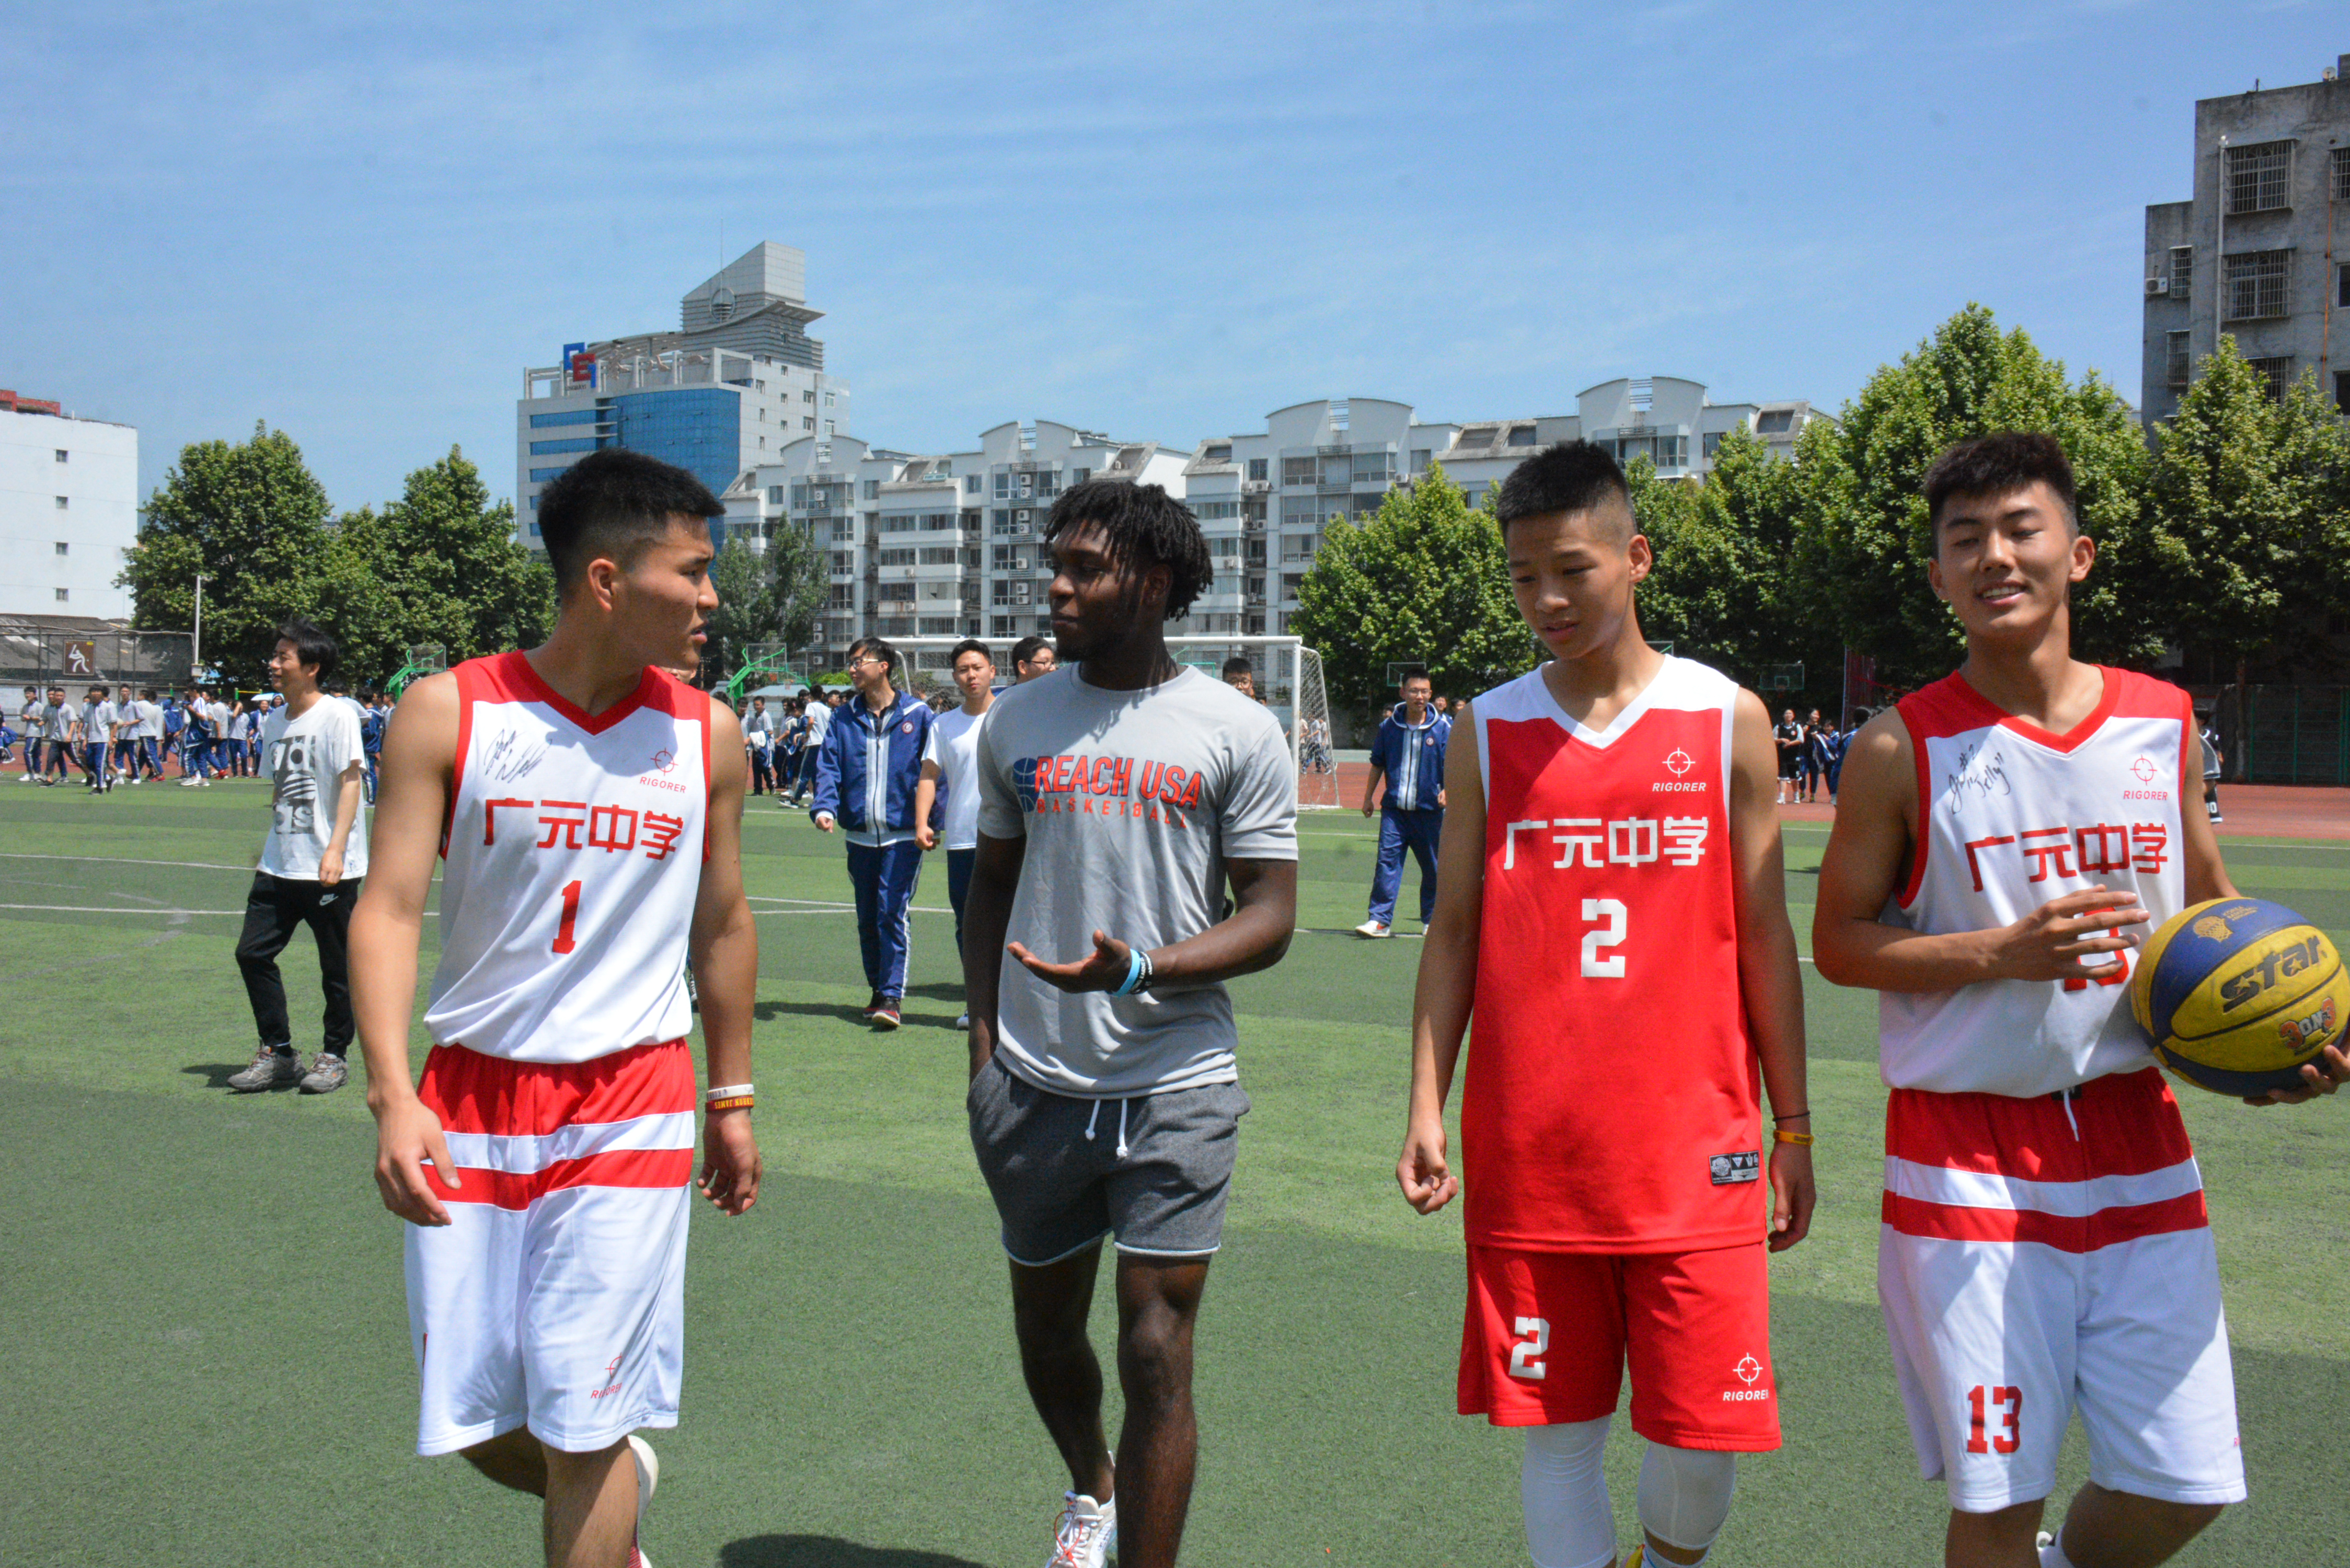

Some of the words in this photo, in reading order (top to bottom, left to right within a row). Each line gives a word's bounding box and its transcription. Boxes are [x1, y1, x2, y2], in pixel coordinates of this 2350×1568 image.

[640, 777, 686, 793] RIGORER
[1033, 755, 1135, 796] REACH
[1139, 760, 1201, 810] USA
[1652, 782, 1707, 792] RIGORER
[2123, 790, 2168, 801] RIGORER
[483, 798, 684, 860] 广元中学
[1036, 798, 1187, 828] BASKETBALL
[1504, 816, 1709, 870] 广元中学
[1964, 822, 2168, 893] 广元中学
[552, 880, 582, 955] 1
[1581, 898, 1627, 978] 2
[1508, 1316, 1550, 1380] 2
[1967, 1385, 2022, 1454] 13
